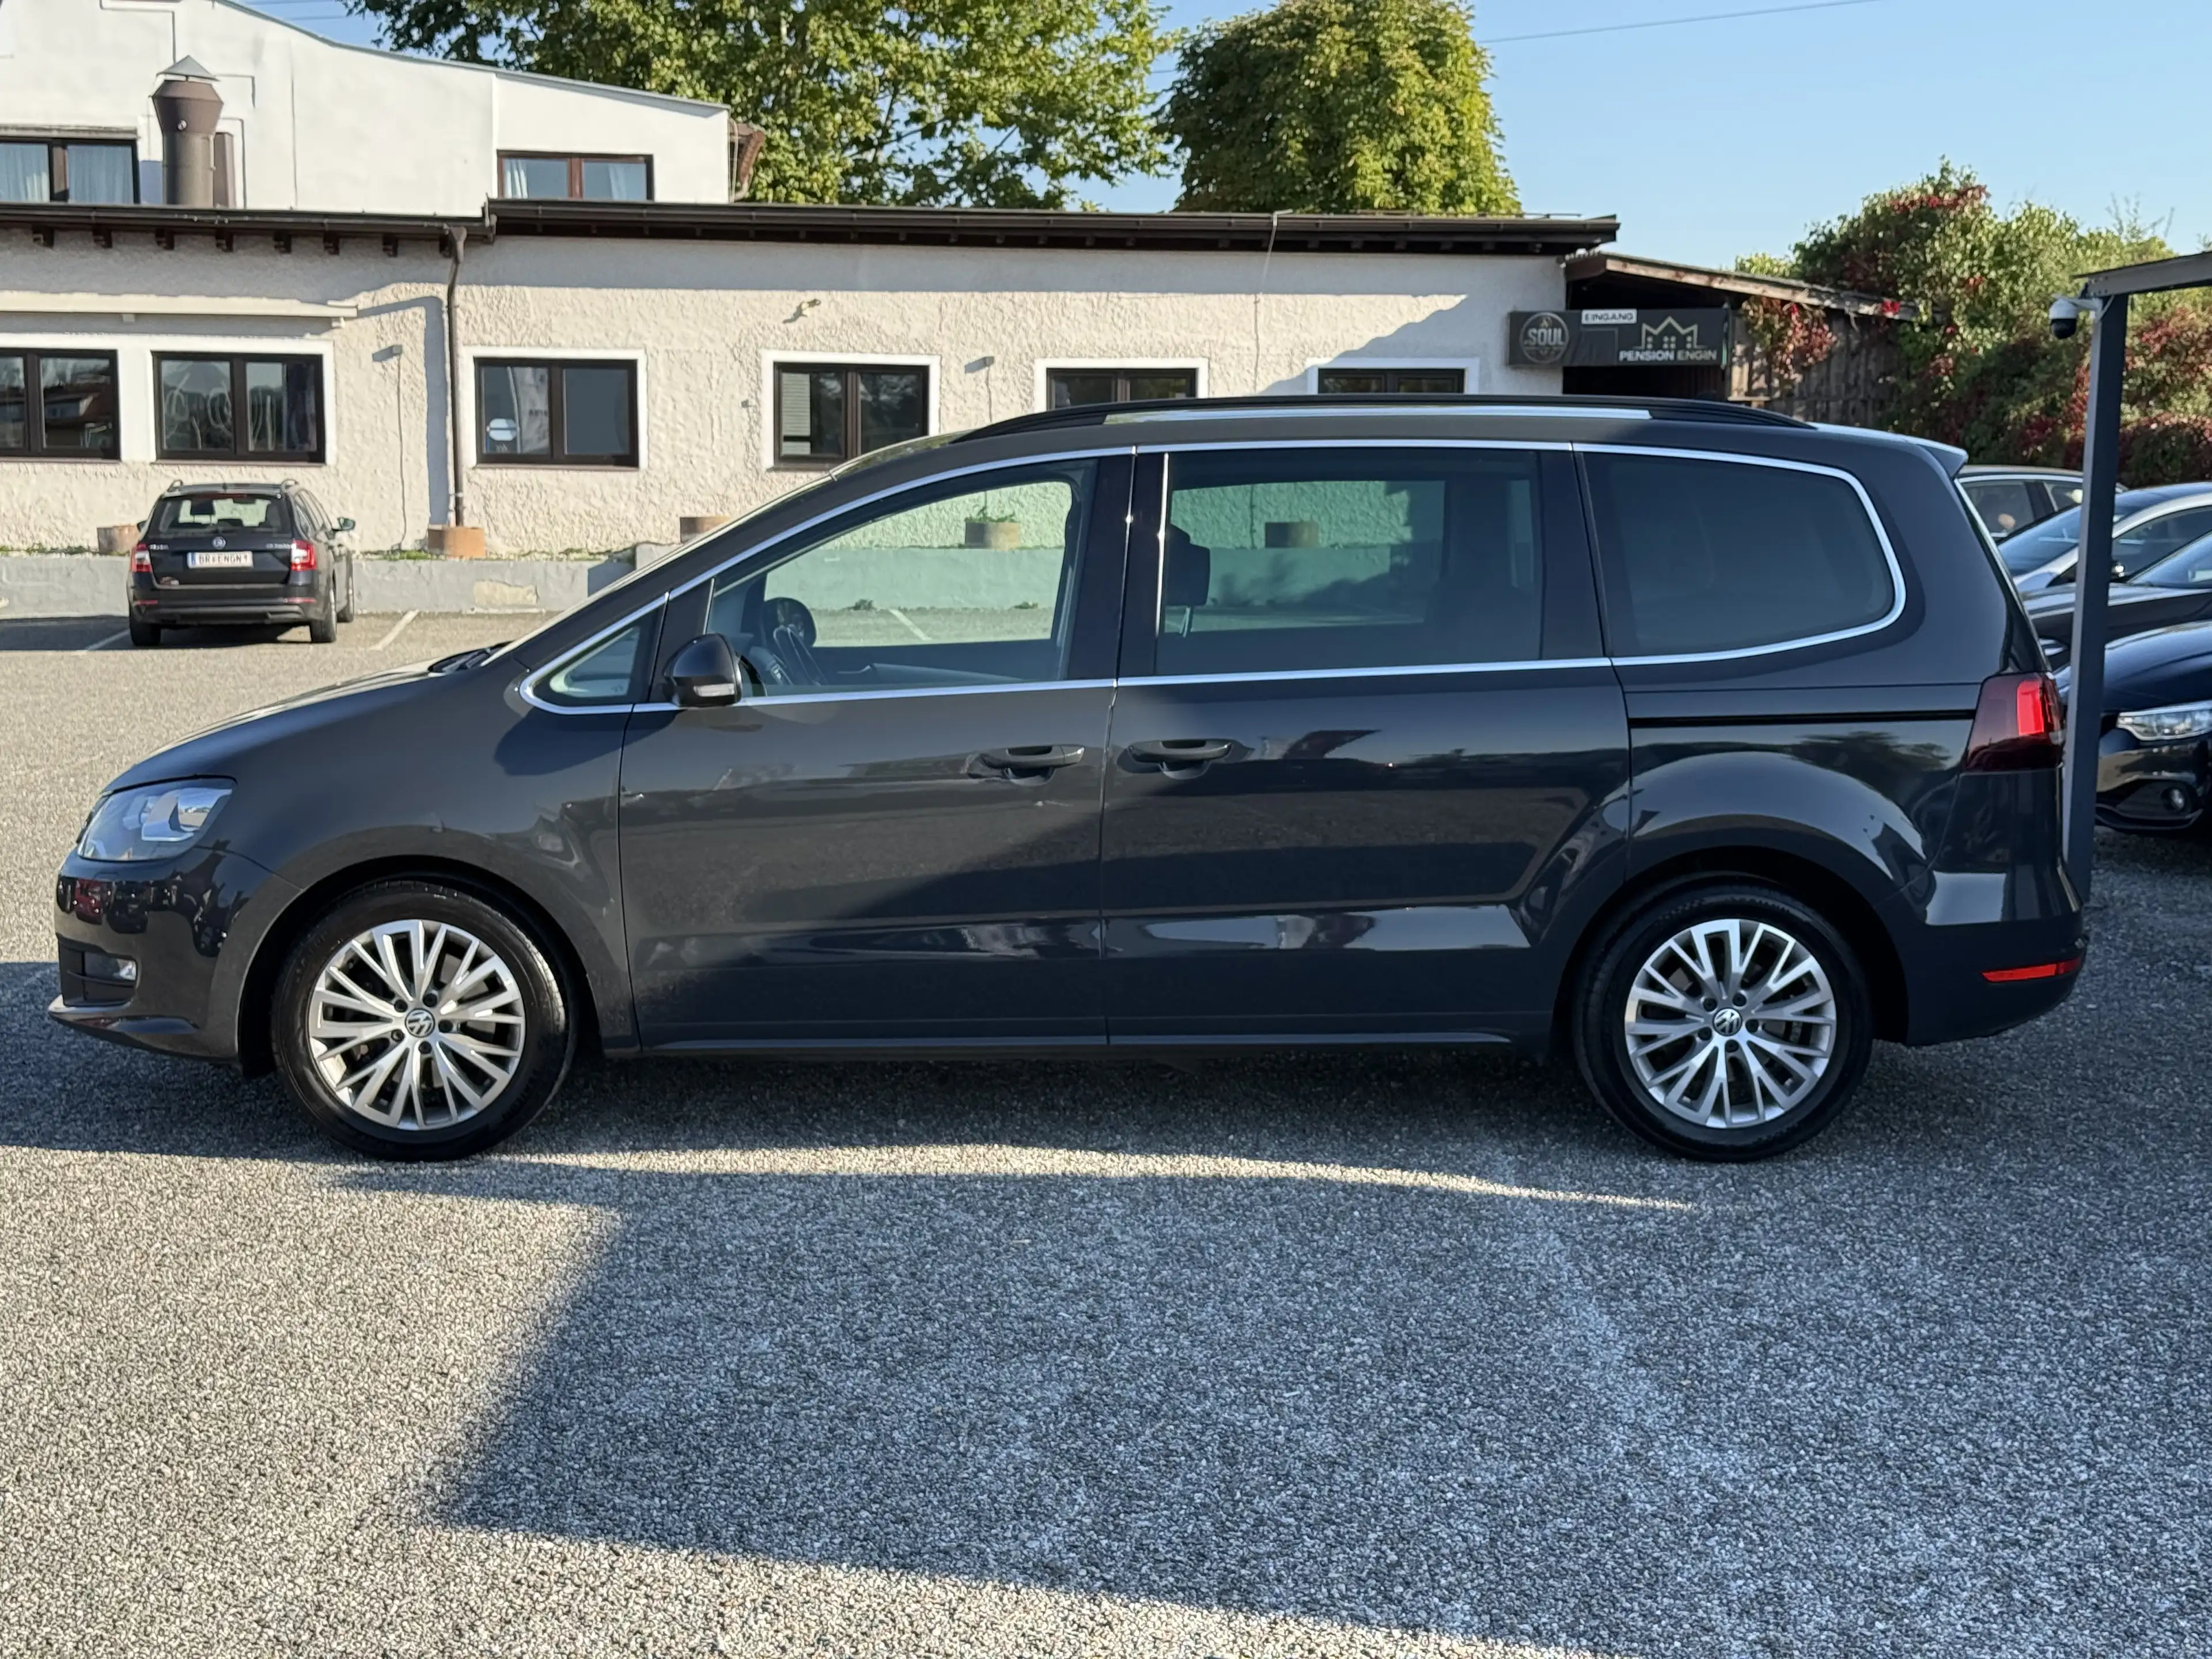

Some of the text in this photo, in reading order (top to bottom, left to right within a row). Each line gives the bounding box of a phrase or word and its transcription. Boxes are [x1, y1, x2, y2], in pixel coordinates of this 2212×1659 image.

[1527, 327, 1565, 346] SOUL
[1619, 349, 1717, 362] PENSION ENGIN
